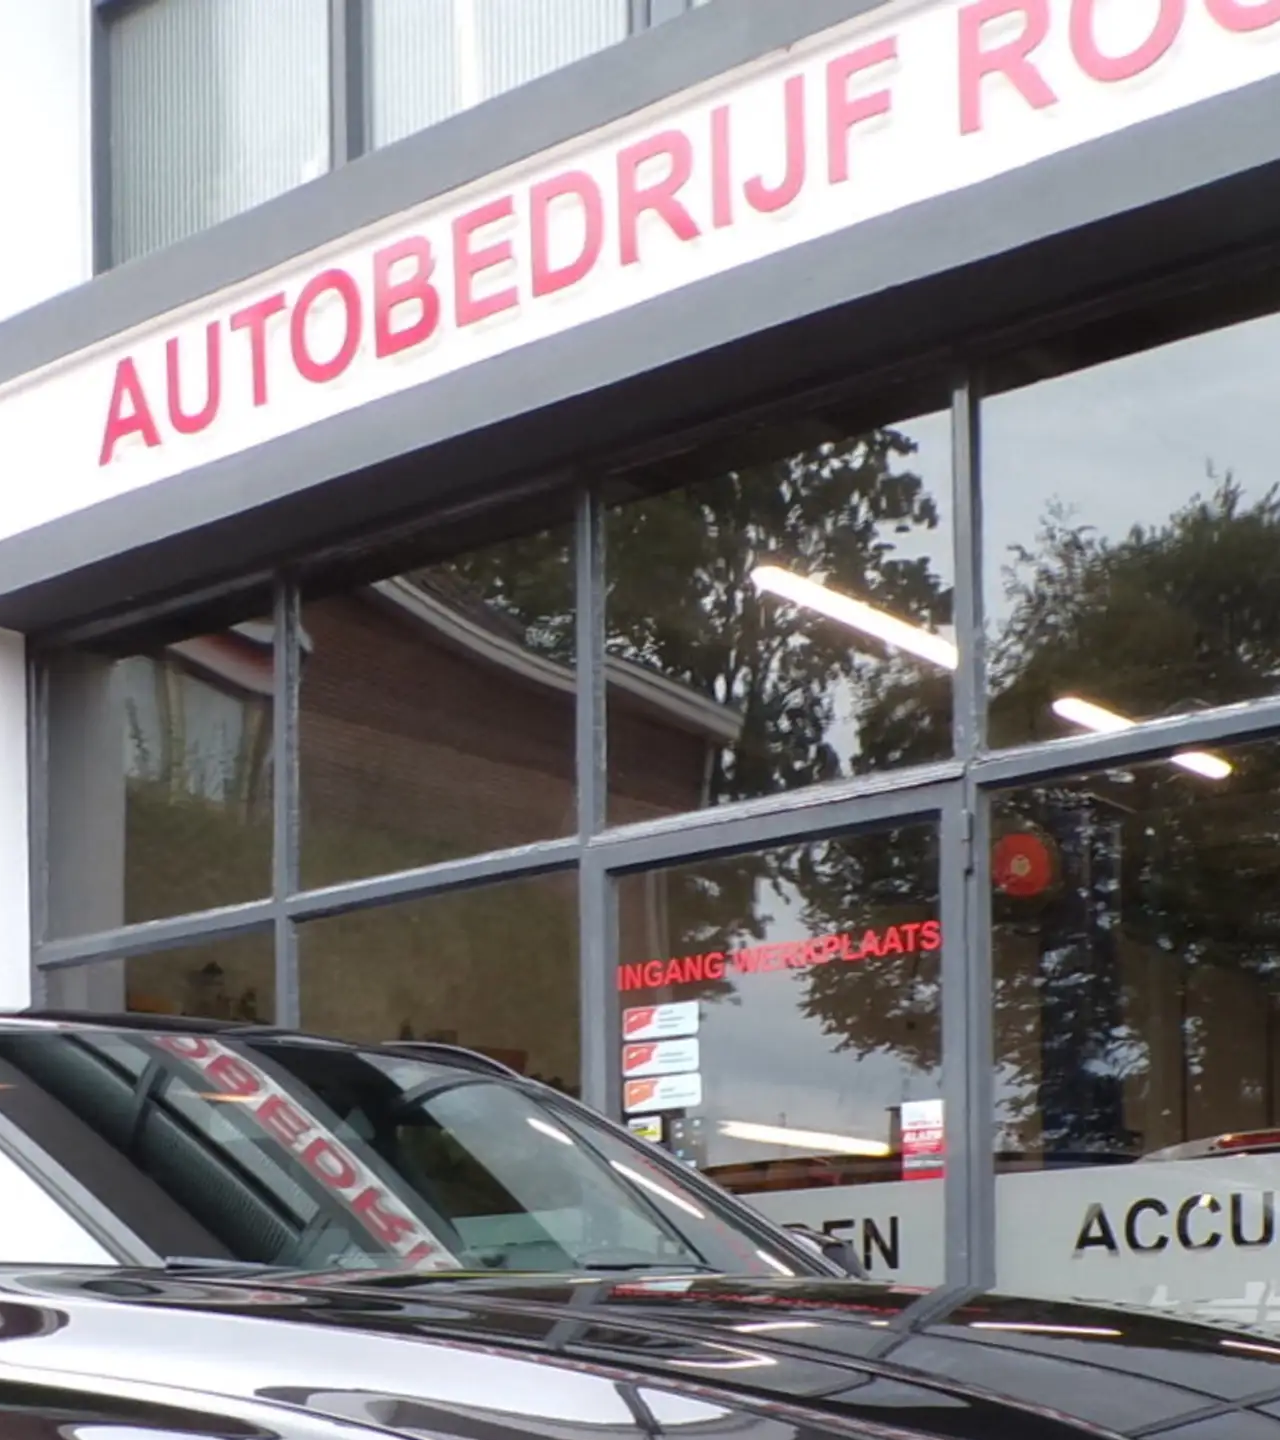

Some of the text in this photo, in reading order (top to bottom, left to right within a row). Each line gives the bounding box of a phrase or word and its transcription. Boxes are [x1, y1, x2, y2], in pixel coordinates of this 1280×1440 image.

[97, 35, 898, 466] AUTOBEDRIJF
[615, 920, 942, 991] INGANG WERKPLAATS
